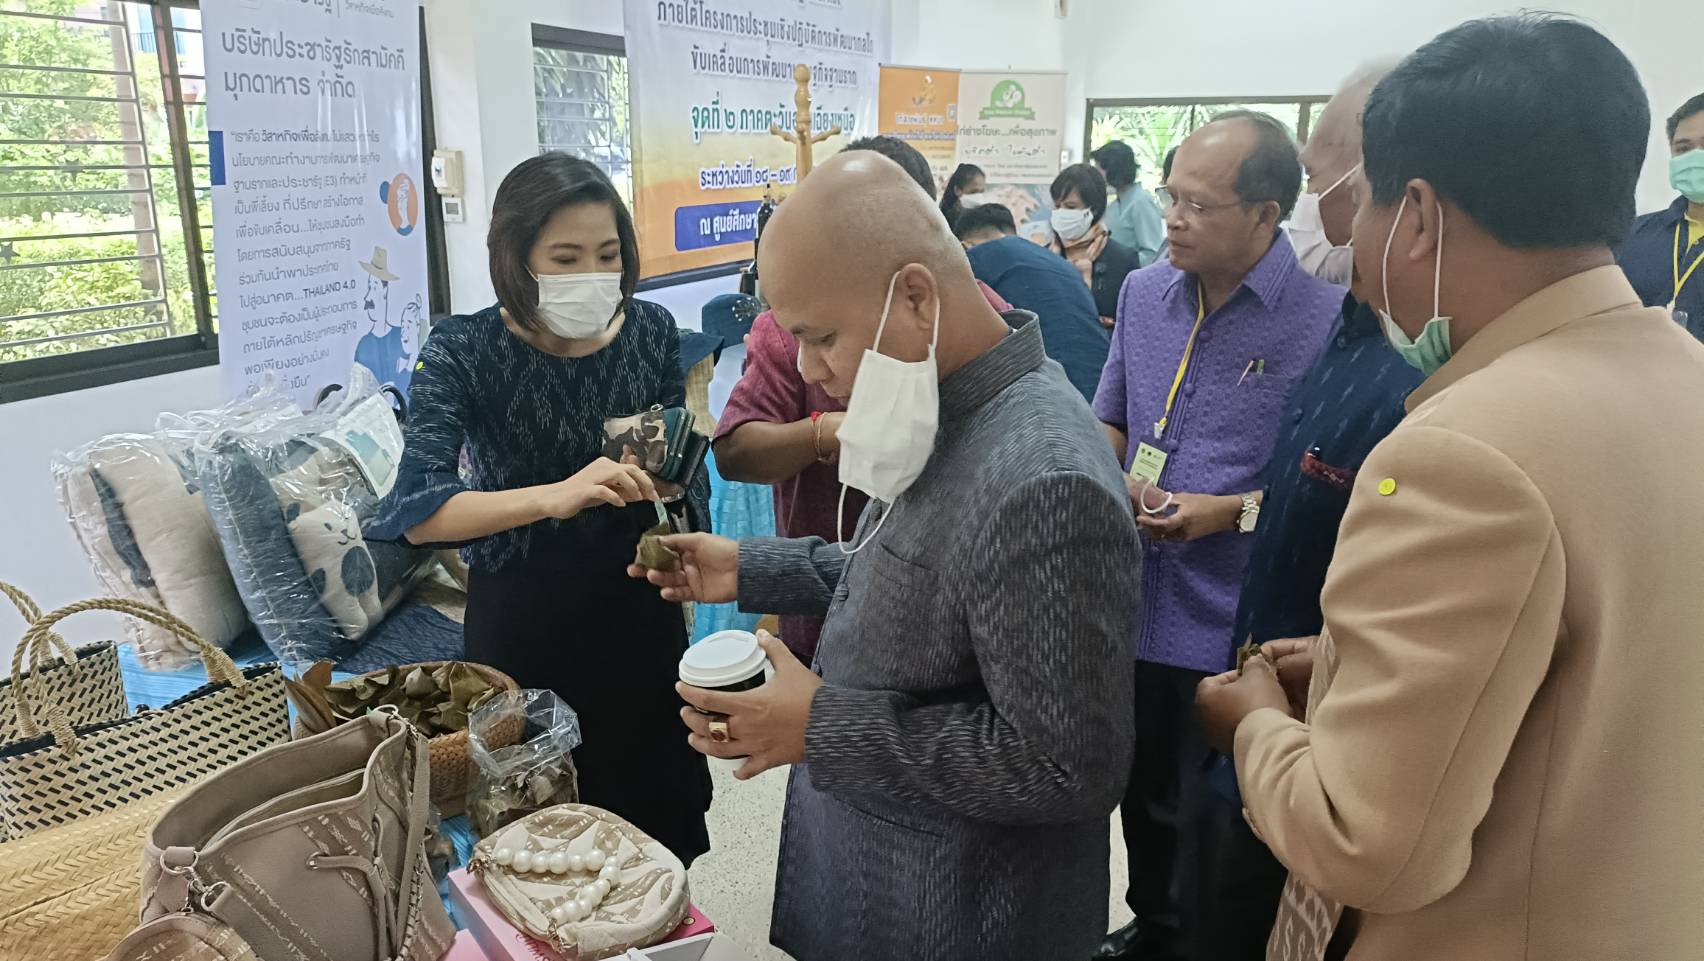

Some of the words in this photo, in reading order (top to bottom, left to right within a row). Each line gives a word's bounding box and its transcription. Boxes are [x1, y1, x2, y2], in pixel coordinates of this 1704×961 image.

[222, 27, 405, 71] บริษัทประชารัฐรักสามัคคี
[224, 71, 311, 101] มุกดาหาร
[691, 91, 720, 140] จุดที่
[725, 108, 736, 129] ๒
[700, 158, 753, 187] ระหว่างวันที่
[700, 217, 711, 237] ณ
